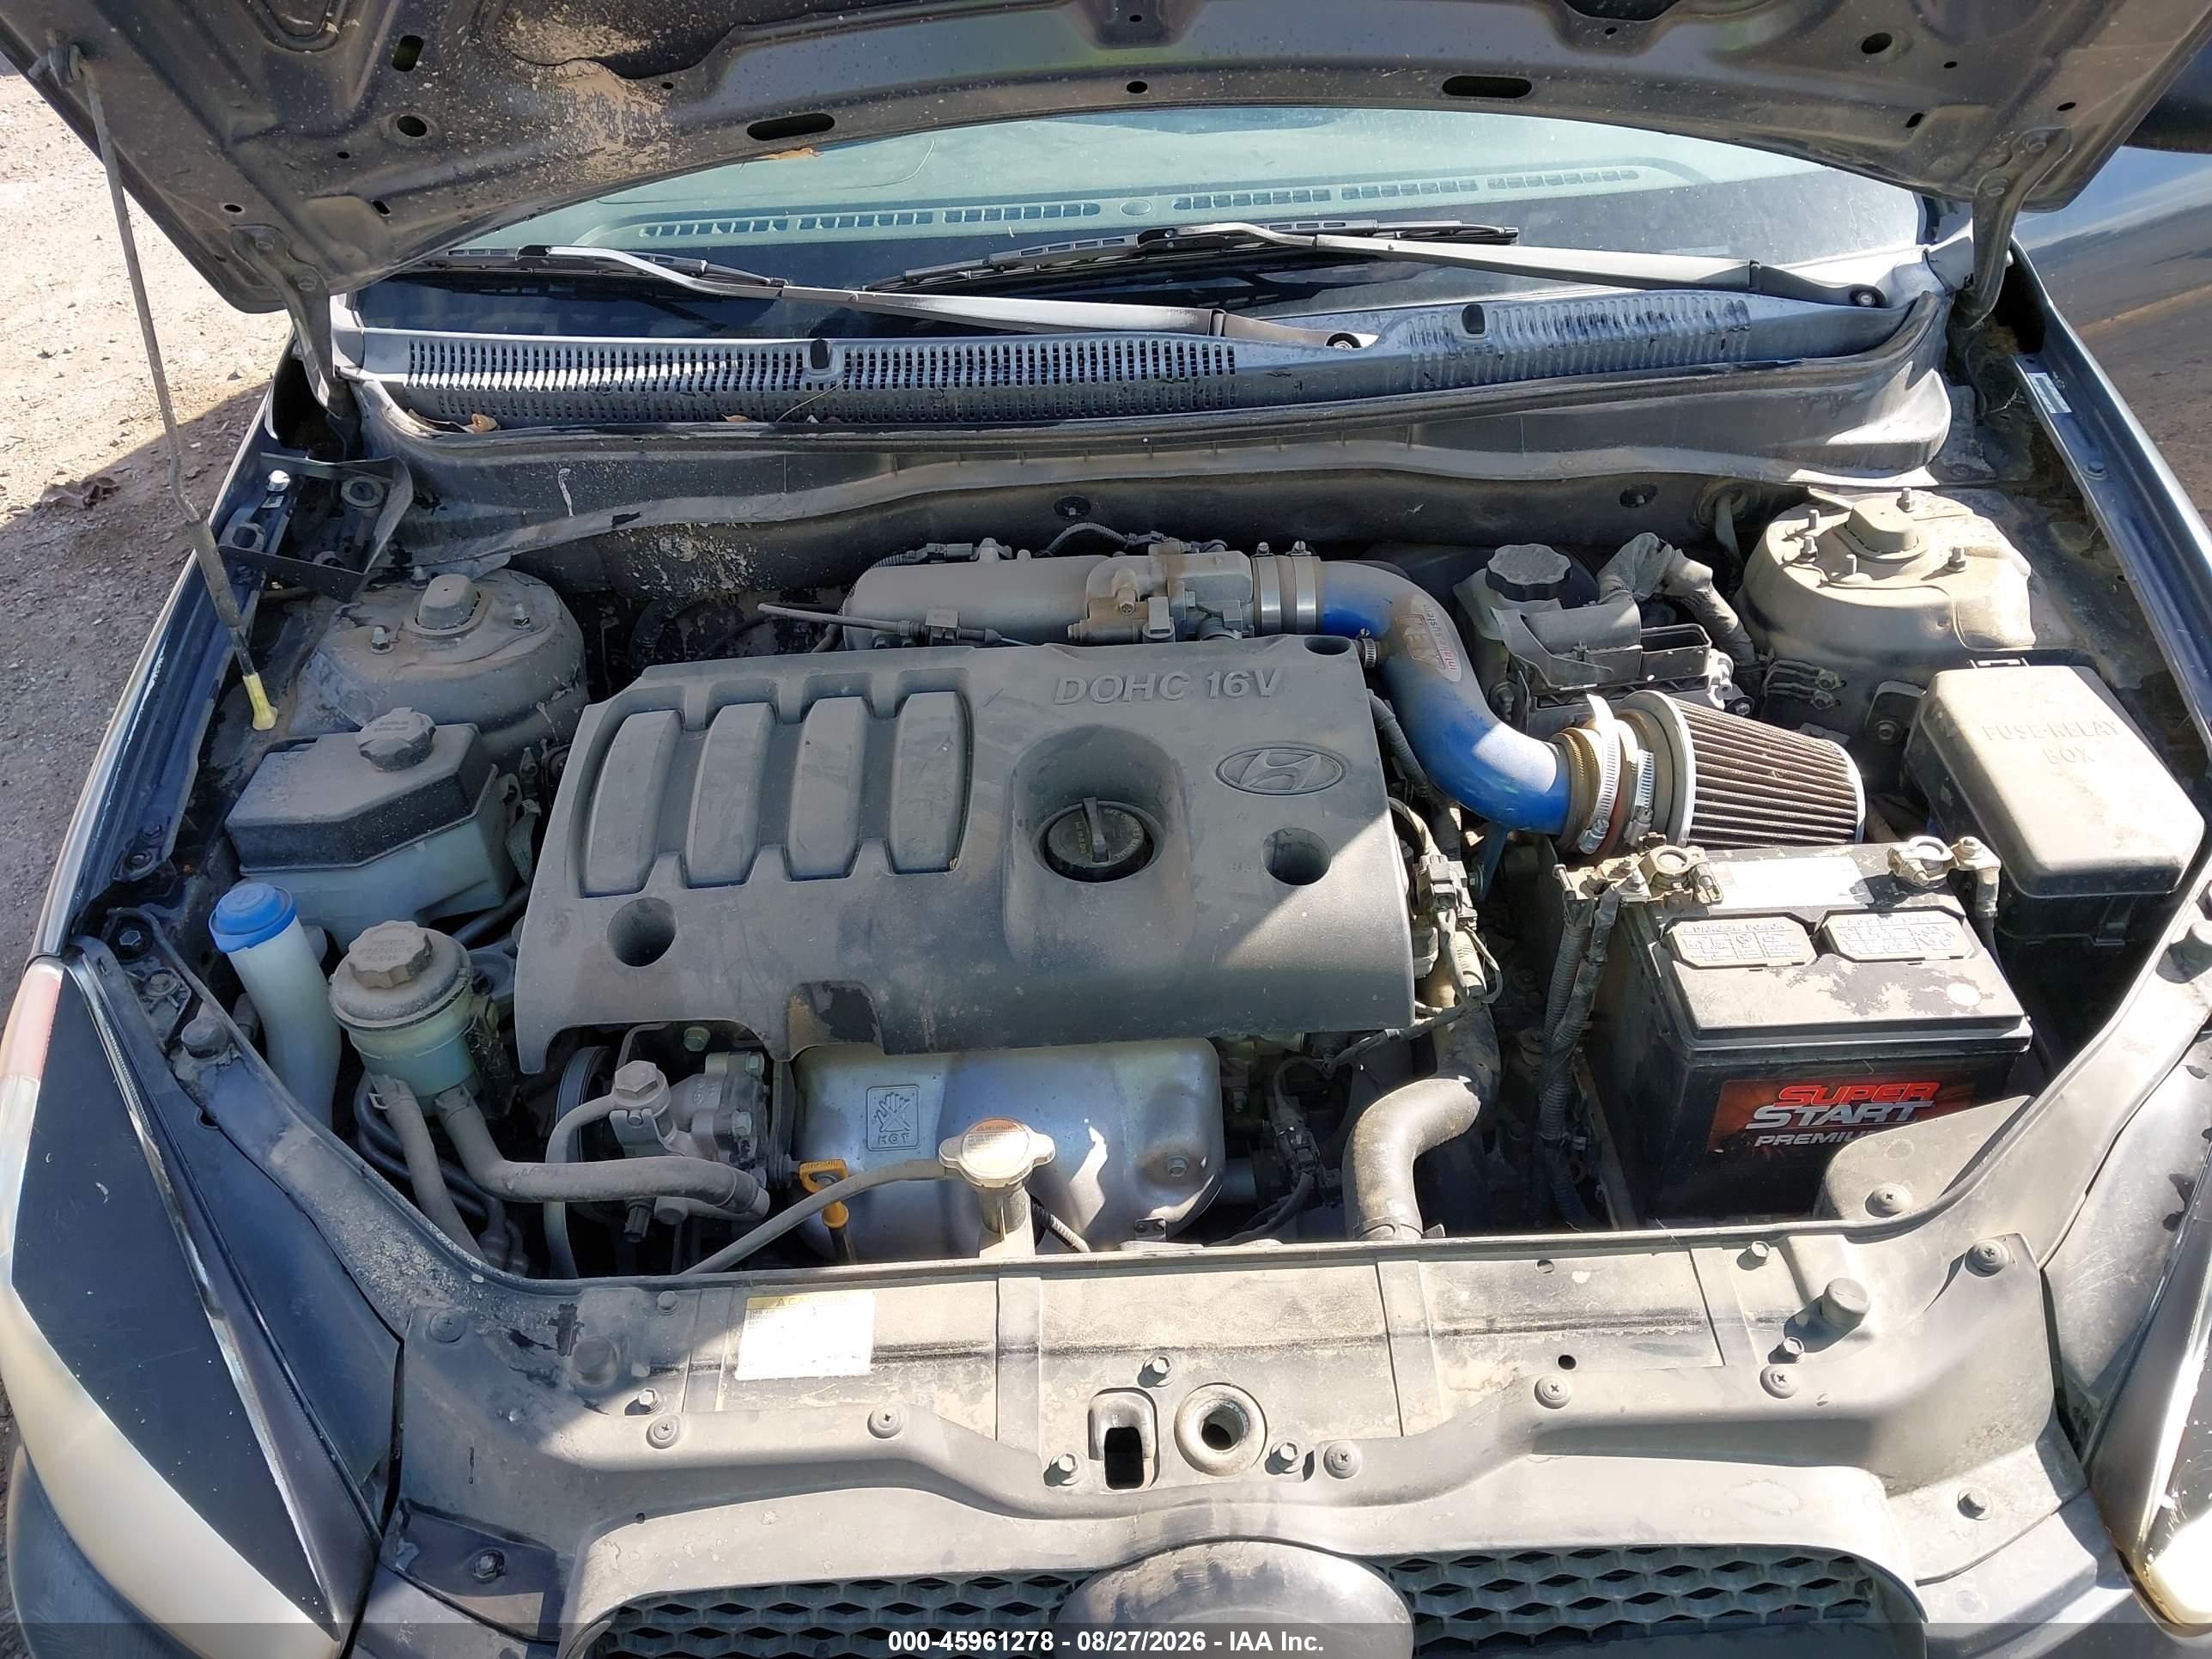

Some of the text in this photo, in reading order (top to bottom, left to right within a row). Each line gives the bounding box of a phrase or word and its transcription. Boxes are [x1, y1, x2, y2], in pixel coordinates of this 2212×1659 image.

[1054, 667, 1280, 706] DOHC 16V
[2041, 744, 2095, 764] BOX
[1773, 1081, 1941, 1108] SUPER
[1745, 1100, 1935, 1130] START
[878, 1133, 910, 1145] HOT
[1754, 1130, 1877, 1147] PREMIU
